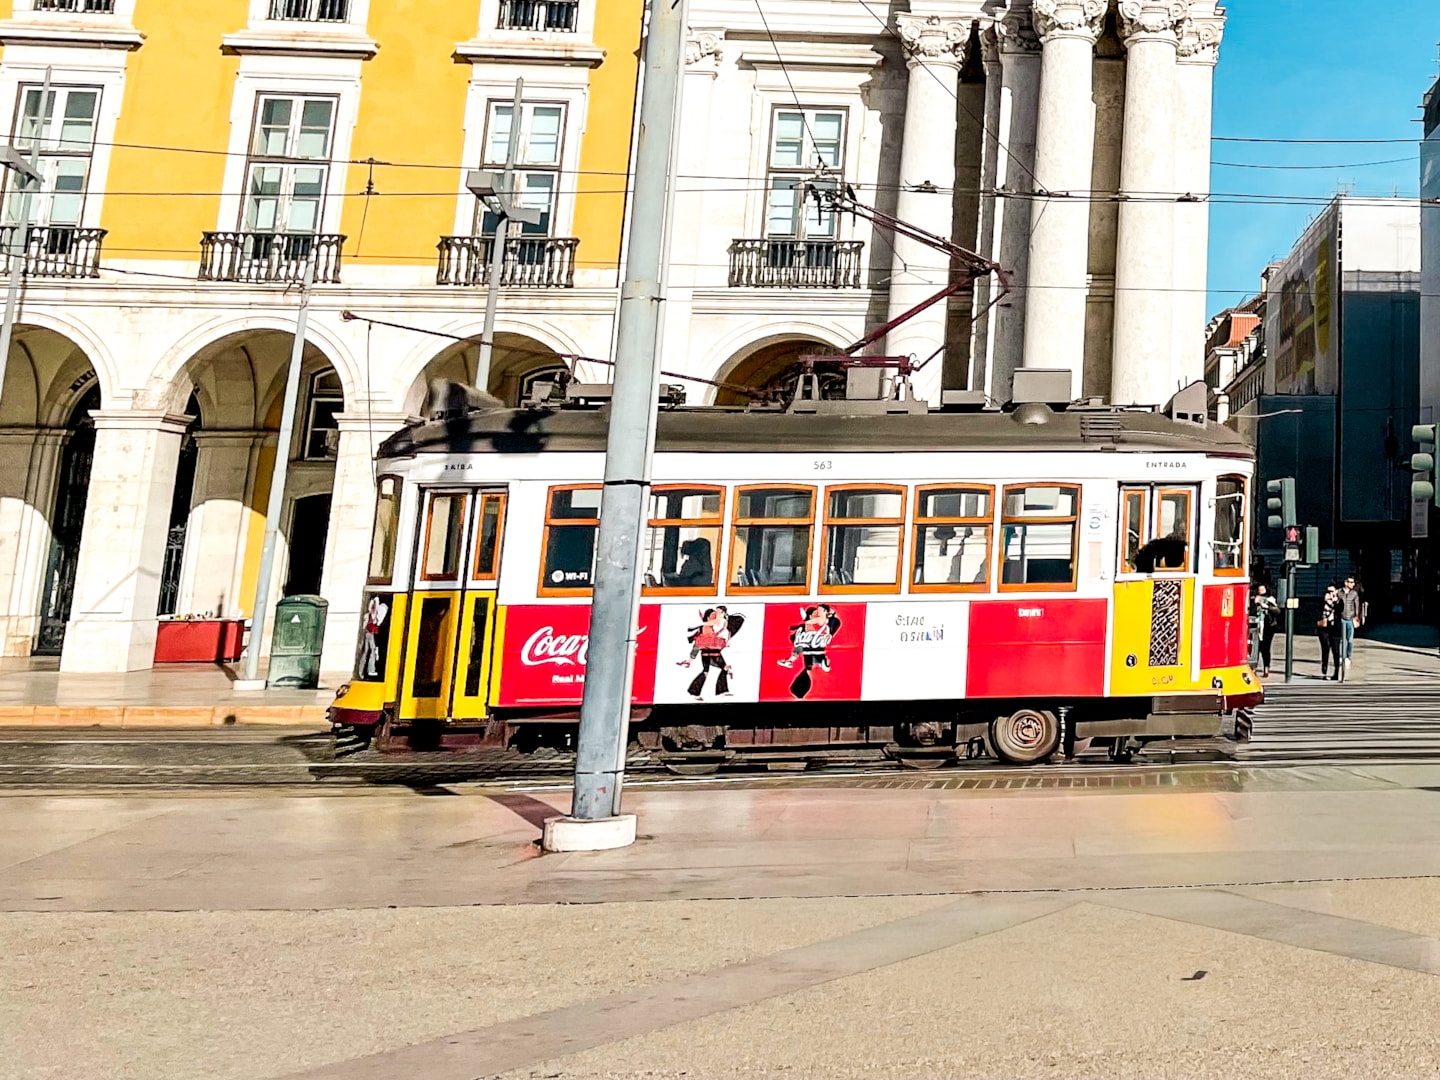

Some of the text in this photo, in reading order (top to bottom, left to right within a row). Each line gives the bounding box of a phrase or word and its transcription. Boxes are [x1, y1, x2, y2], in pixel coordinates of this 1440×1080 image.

[813, 460, 833, 470] 563
[1145, 461, 1187, 469] ENTRADA
[565, 572, 588, 581] WI-FI
